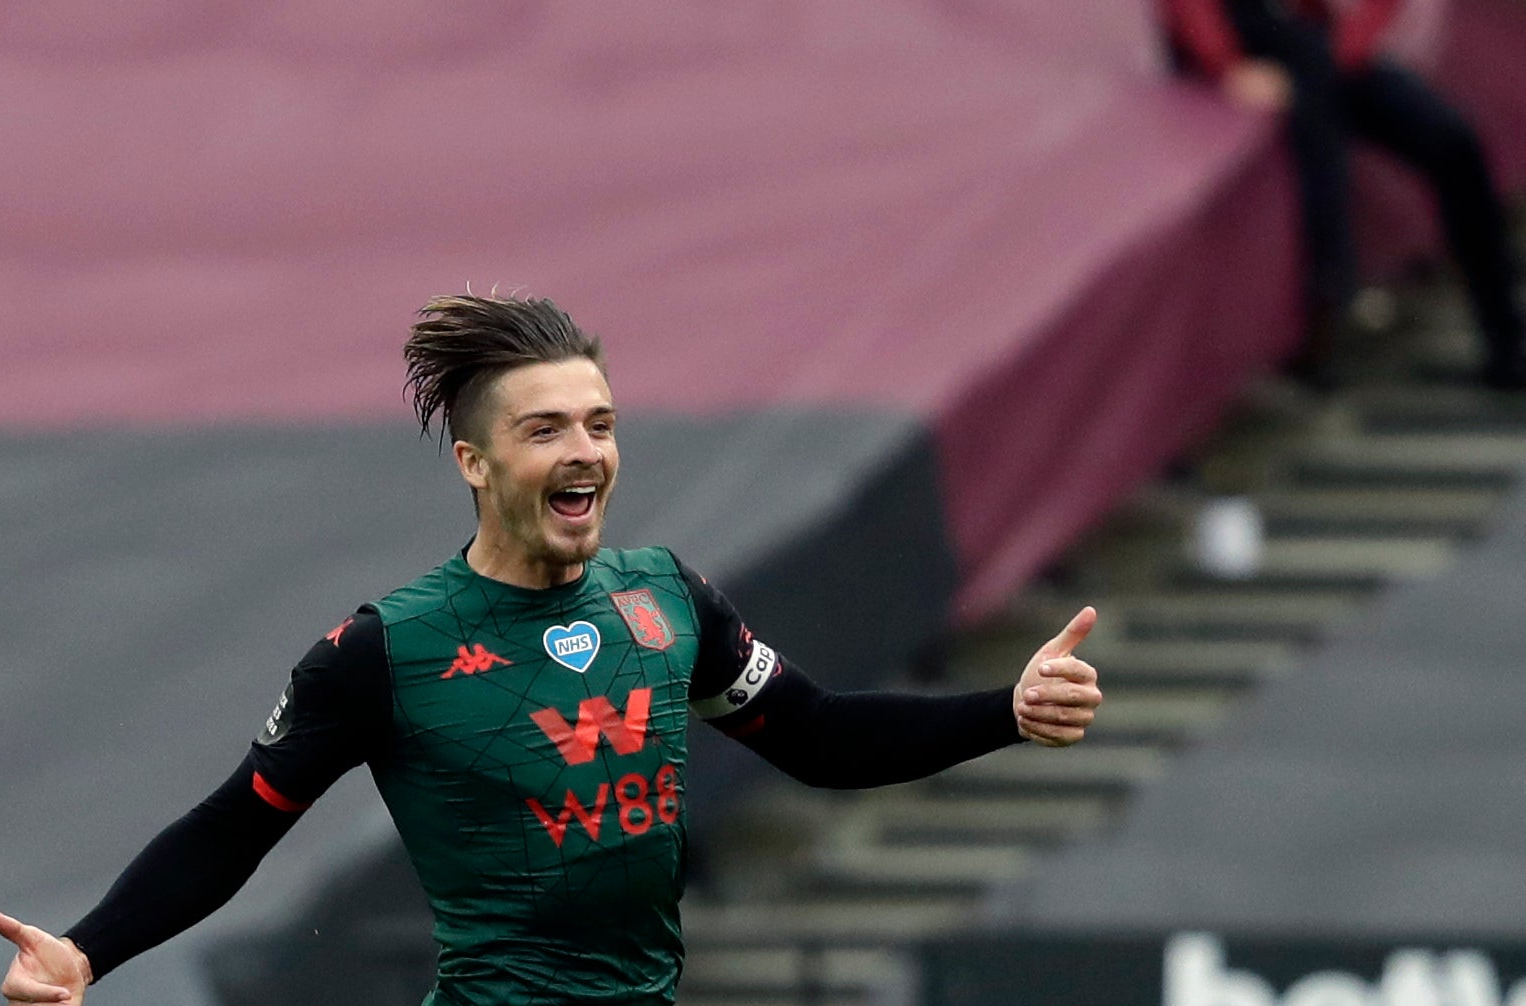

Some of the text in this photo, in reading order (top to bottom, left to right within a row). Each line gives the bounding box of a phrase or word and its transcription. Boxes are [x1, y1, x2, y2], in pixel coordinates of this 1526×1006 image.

[558, 635, 590, 654] NHS
[745, 640, 774, 685] Cap
[525, 764, 679, 848] W88
